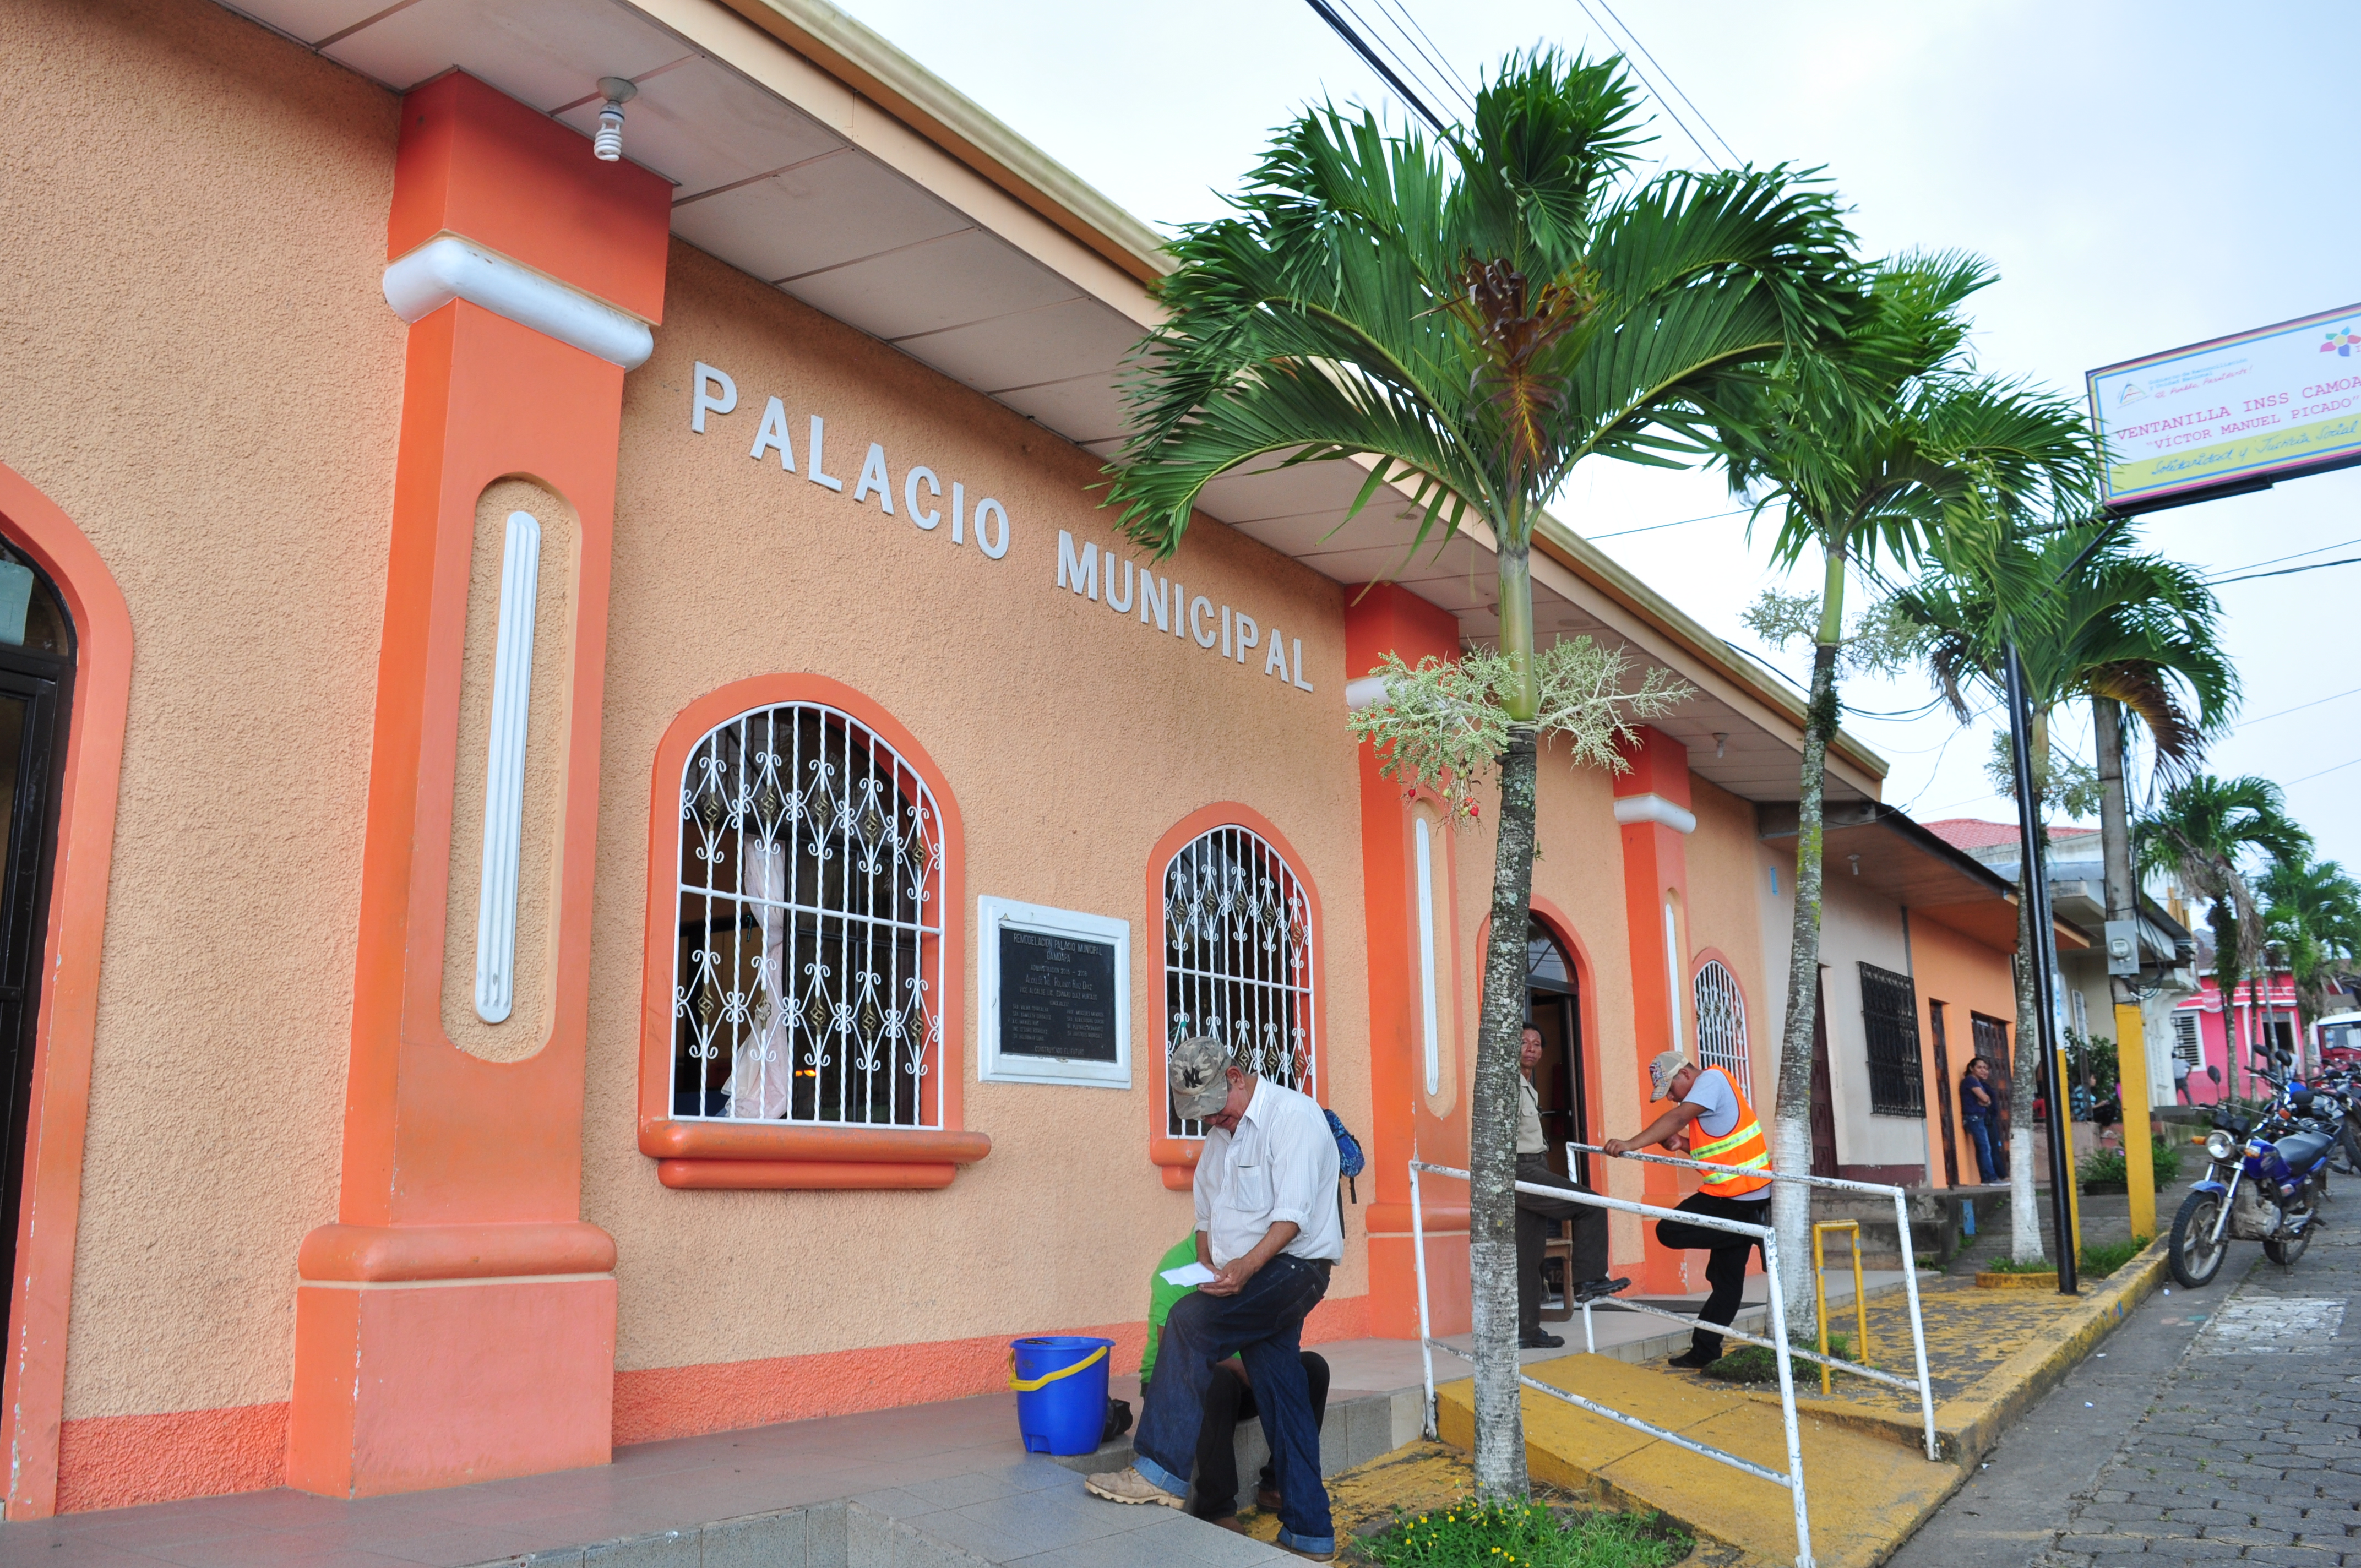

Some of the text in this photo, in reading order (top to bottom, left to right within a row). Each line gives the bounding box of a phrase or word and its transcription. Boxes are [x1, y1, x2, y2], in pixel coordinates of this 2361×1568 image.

[2117, 406, 2232, 440] VENTANILLA
[2243, 392, 2289, 412] INSS
[2221, 414, 2281, 435] MANUEL
[2151, 448, 2234, 475] Solidaridad
[2239, 447, 2248, 462] y
[2316, 420, 2358, 440] Social
[692, 361, 1313, 692] PALACIO MUNICIPAL
[1054, 940, 1075, 952] PALACIO
[1078, 944, 1102, 956] MUNICIPAL
